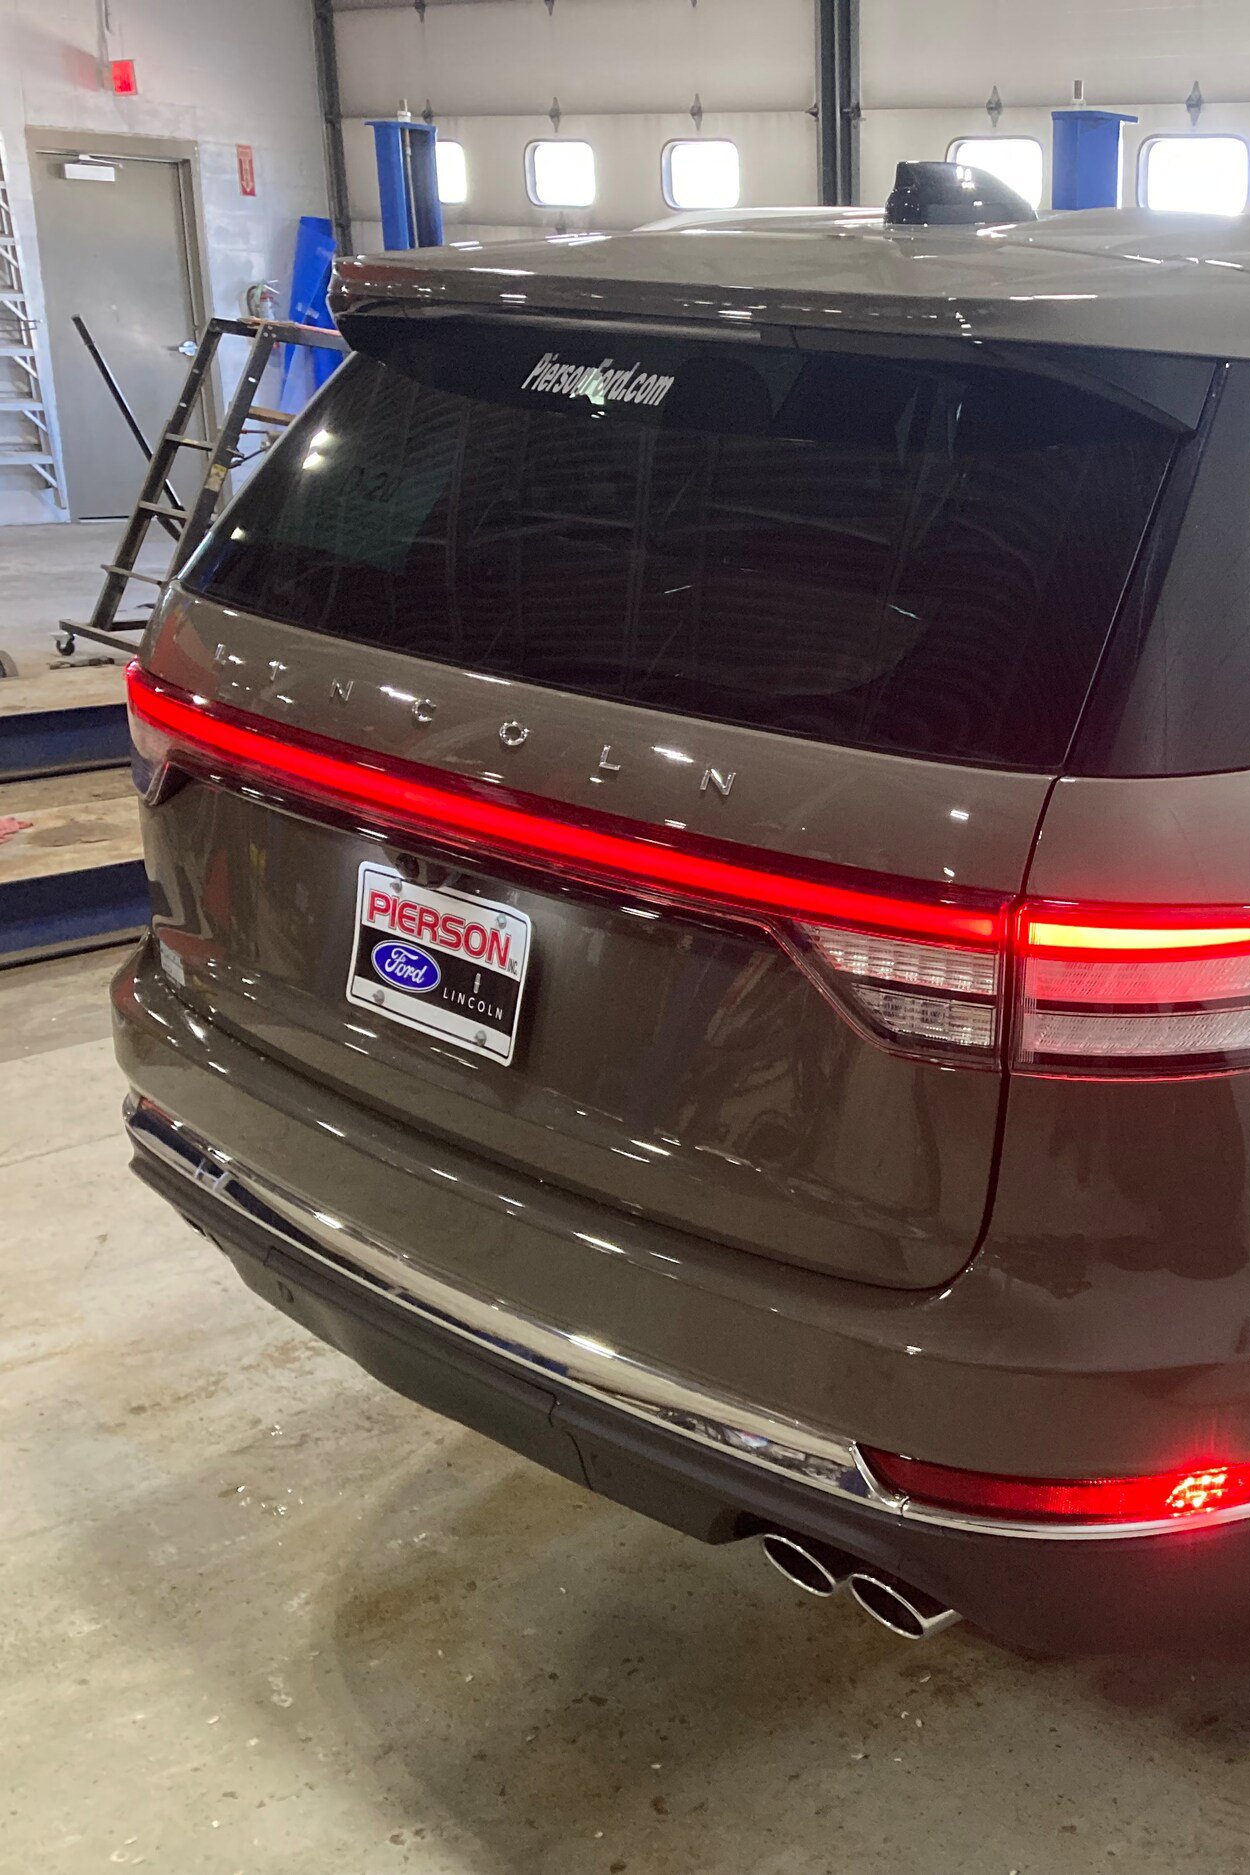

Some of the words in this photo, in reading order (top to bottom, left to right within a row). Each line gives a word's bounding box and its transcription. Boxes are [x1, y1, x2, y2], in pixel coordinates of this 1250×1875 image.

[521, 353, 675, 406] PiersonFord.com
[213, 643, 737, 797] LINCOLN
[367, 888, 512, 969] PIERSON
[384, 947, 428, 985] Ford
[443, 987, 503, 1020] LINCOLN
